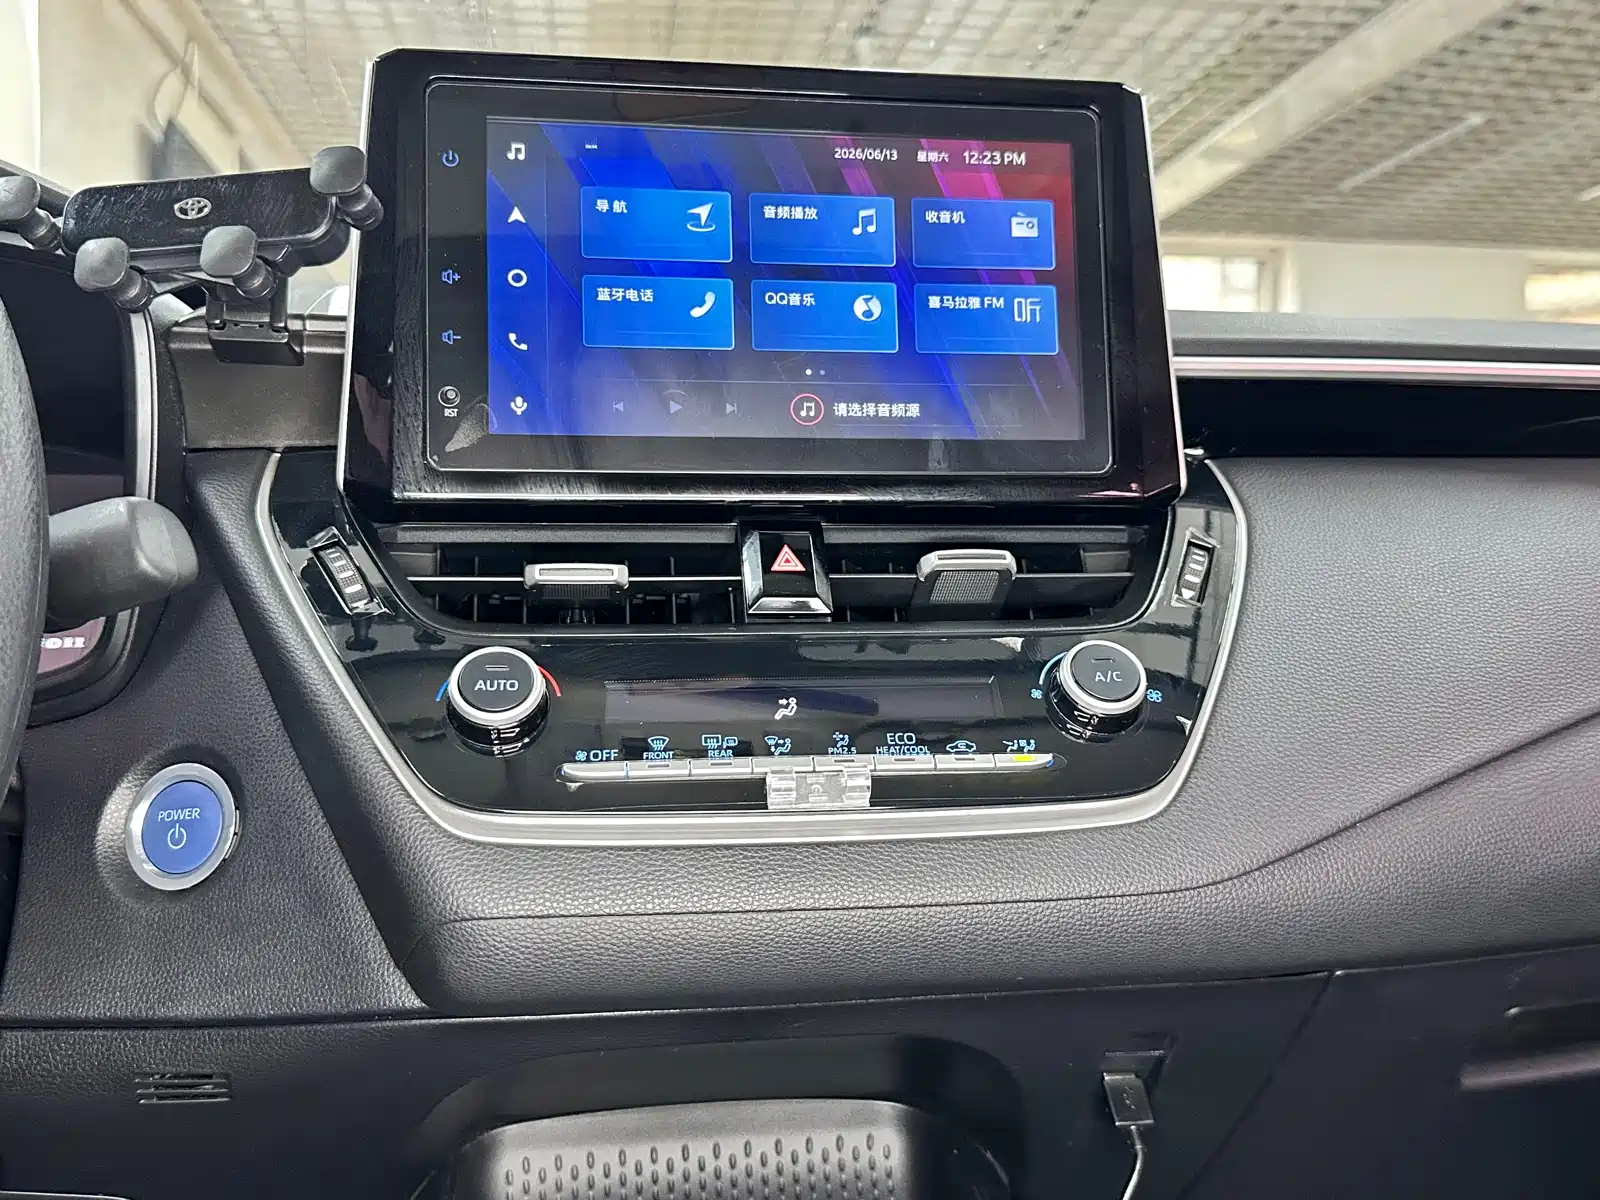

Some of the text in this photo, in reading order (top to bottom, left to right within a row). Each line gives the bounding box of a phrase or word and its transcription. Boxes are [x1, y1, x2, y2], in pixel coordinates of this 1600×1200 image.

[834, 147, 898, 161] 2026/06/13
[917, 151, 949, 163] 星期六
[963, 151, 1026, 166] 12:23 PM
[595, 199, 628, 214] 导航
[763, 205, 818, 221] 音频播放
[925, 210, 966, 225] 收音机
[597, 287, 654, 303] 蓝牙电话
[765, 292, 816, 307] QQ音乐
[928, 295, 1004, 310] 喜马拉雅 FM
[444, 408, 459, 418] RST
[833, 402, 921, 418] 请选择音频源
[1095, 671, 1123, 683] A/C
[474, 679, 519, 691] AUTO
[886, 732, 916, 745] ECO
[590, 749, 619, 761] OFF
[643, 750, 674, 760] FRONT
[707, 749, 733, 758] REAR
[828, 746, 857, 755] PM2.5
[876, 745, 931, 755] HEAT/COOL
[157, 806, 200, 822] POWER
